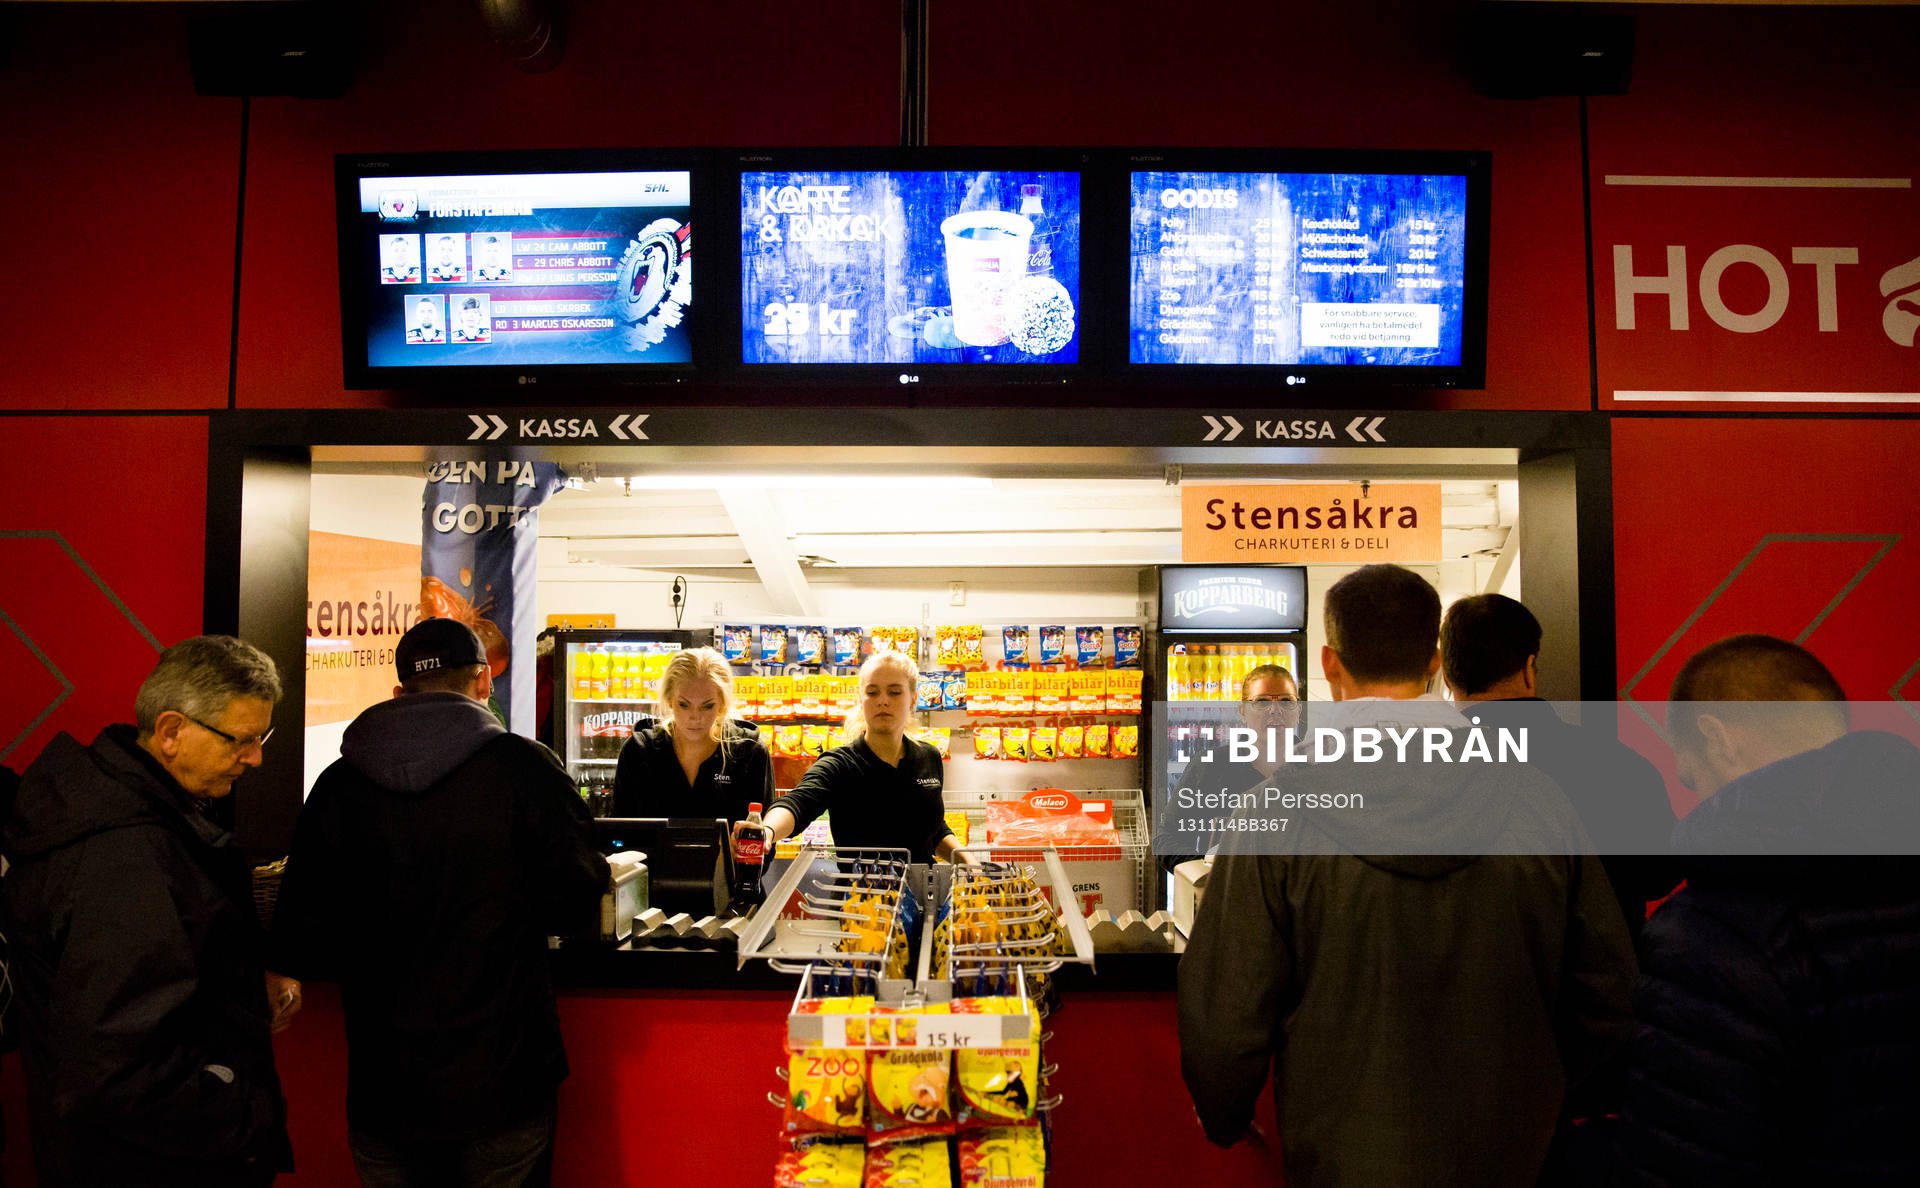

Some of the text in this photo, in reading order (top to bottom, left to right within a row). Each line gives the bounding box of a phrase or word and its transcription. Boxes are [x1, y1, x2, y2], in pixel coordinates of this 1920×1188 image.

[1161, 188, 1238, 209] GODIS
[760, 214, 783, 242] &
[548, 242, 569, 252] CAM
[572, 241, 607, 251] ABBOTT
[1408, 249, 1424, 259] 20
[517, 257, 613, 268] C 29 CHRIS ABBOTT
[577, 273, 617, 282] PERSSON
[1613, 244, 1859, 333] HOT
[512, 320, 519, 329] 3
[521, 320, 559, 329] MARCUS
[561, 319, 614, 328] OSKARSSON
[519, 419, 599, 438] KASSA
[1255, 420, 1335, 439] KASSA
[1206, 499, 1418, 530] Stensåkra
[1235, 538, 1389, 550] CHARKUTERI & DELI
[1174, 585, 1288, 618] KOPPARBERG
[415, 657, 441, 673] HV71
[737, 683, 754, 694] lar
[758, 683, 789, 694] bilar
[795, 680, 826, 693] bilar
[999, 678, 1031, 690] bilar
[1034, 678, 1066, 690] bilar
[1072, 678, 1104, 690] bilar
[1108, 677, 1141, 689] bilar
[1035, 797, 1066, 807] Malaco
[927, 1032, 971, 1046] 15 kr
[807, 1057, 860, 1077] ZOO
